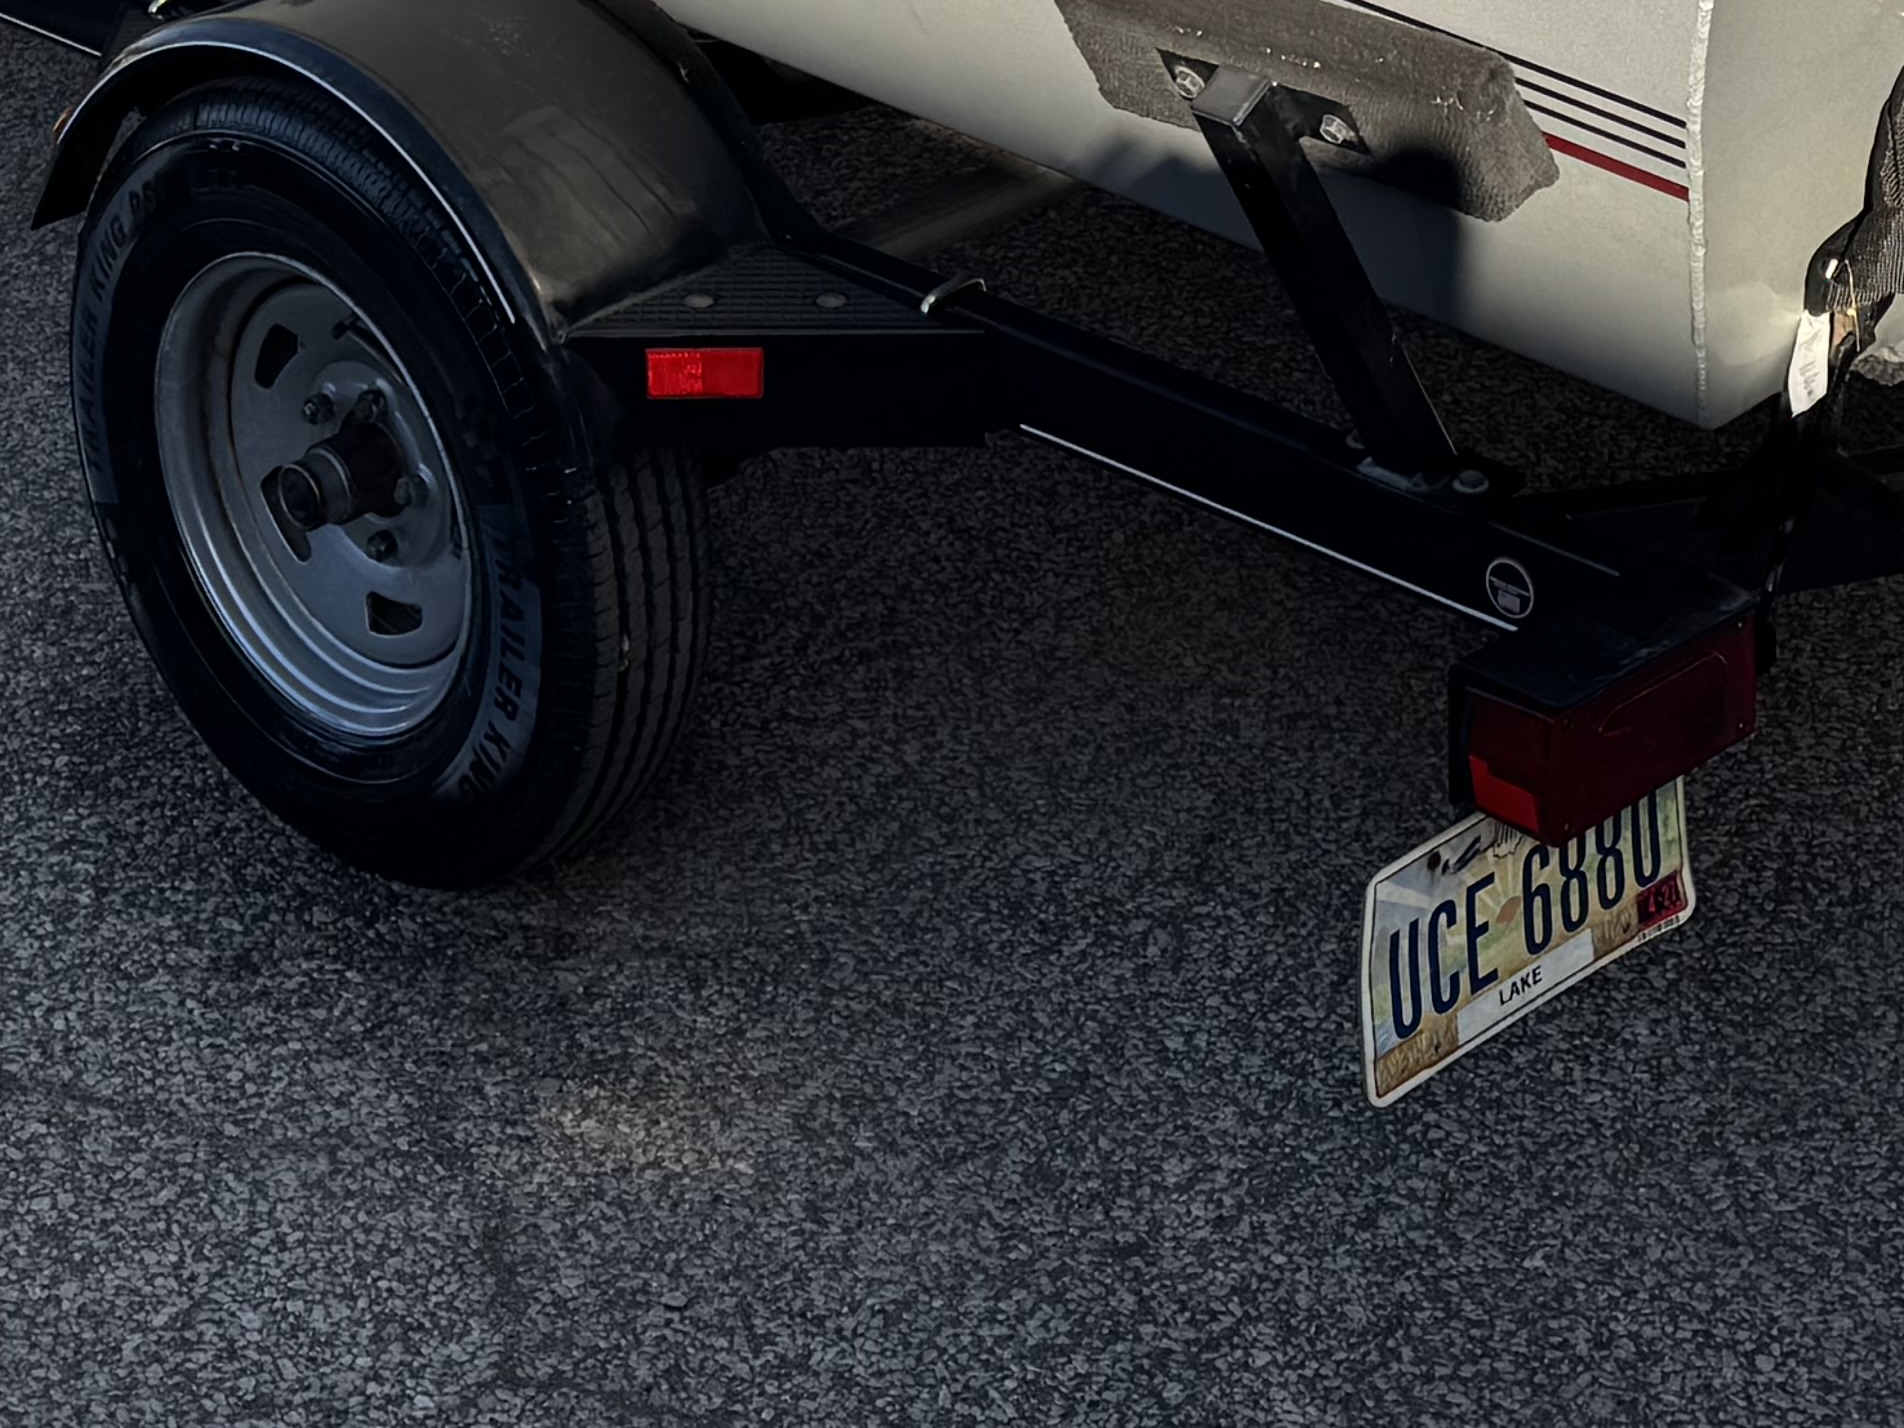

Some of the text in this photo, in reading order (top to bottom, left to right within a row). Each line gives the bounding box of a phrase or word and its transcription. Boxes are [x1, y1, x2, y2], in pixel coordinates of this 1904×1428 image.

[1389, 792, 1661, 1040] UCE 6880
[1498, 965, 1543, 1006] LAKE
